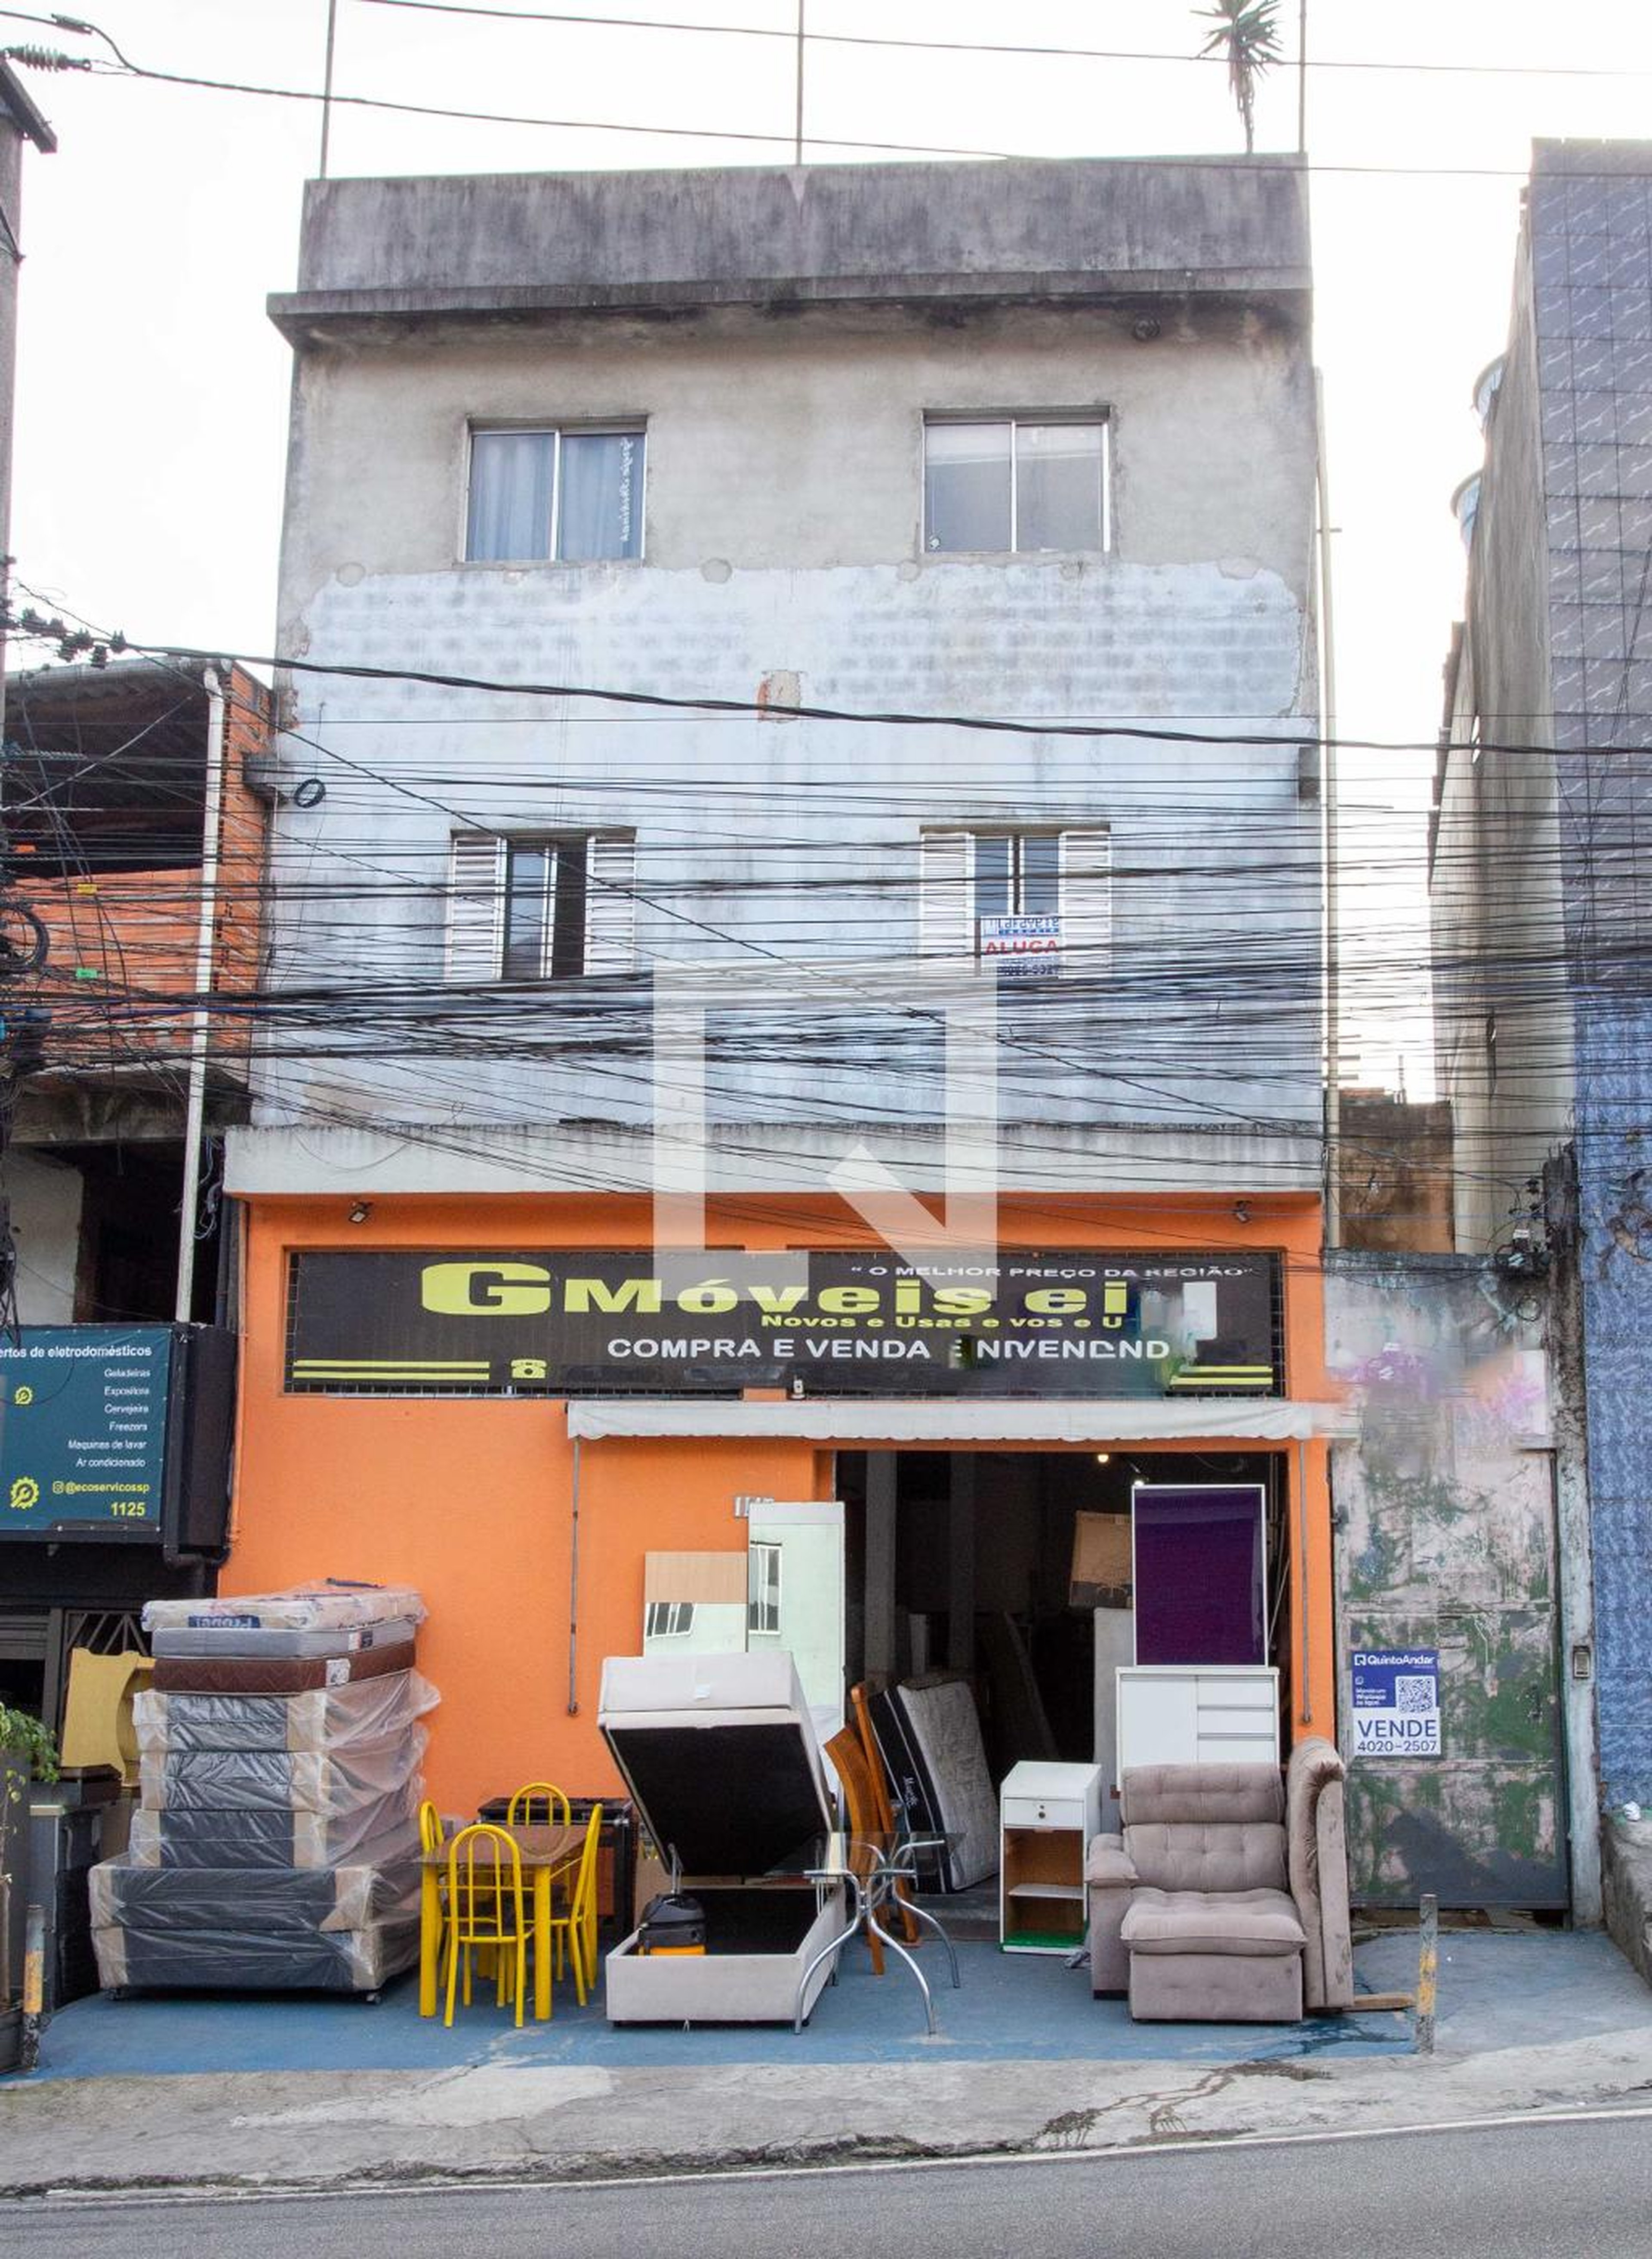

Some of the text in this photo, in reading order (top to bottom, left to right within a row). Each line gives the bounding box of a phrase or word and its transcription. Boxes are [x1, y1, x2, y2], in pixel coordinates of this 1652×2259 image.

[895, 1267, 1001, 1276] MELHOR
[1009, 1269, 1096, 1278] PREÇO
[1104, 1269, 1138, 1277] DA
[761, 1315, 856, 1327] Novos
[30, 1346, 45, 1358] de
[48, 1345, 152, 1358] eletrodomésticos
[607, 1338, 762, 1358] COMPRA
[773, 1339, 795, 1358] E
[805, 1339, 931, 1359] VENDA
[76, 1458, 145, 1467] Ar condicionado
[111, 1502, 145, 1516] 1125
[1367, 1655, 1435, 1665] QuintoAndar
[1357, 1720, 1437, 1737] VENDE
[1357, 1741, 1436, 1752] 4020-2507
